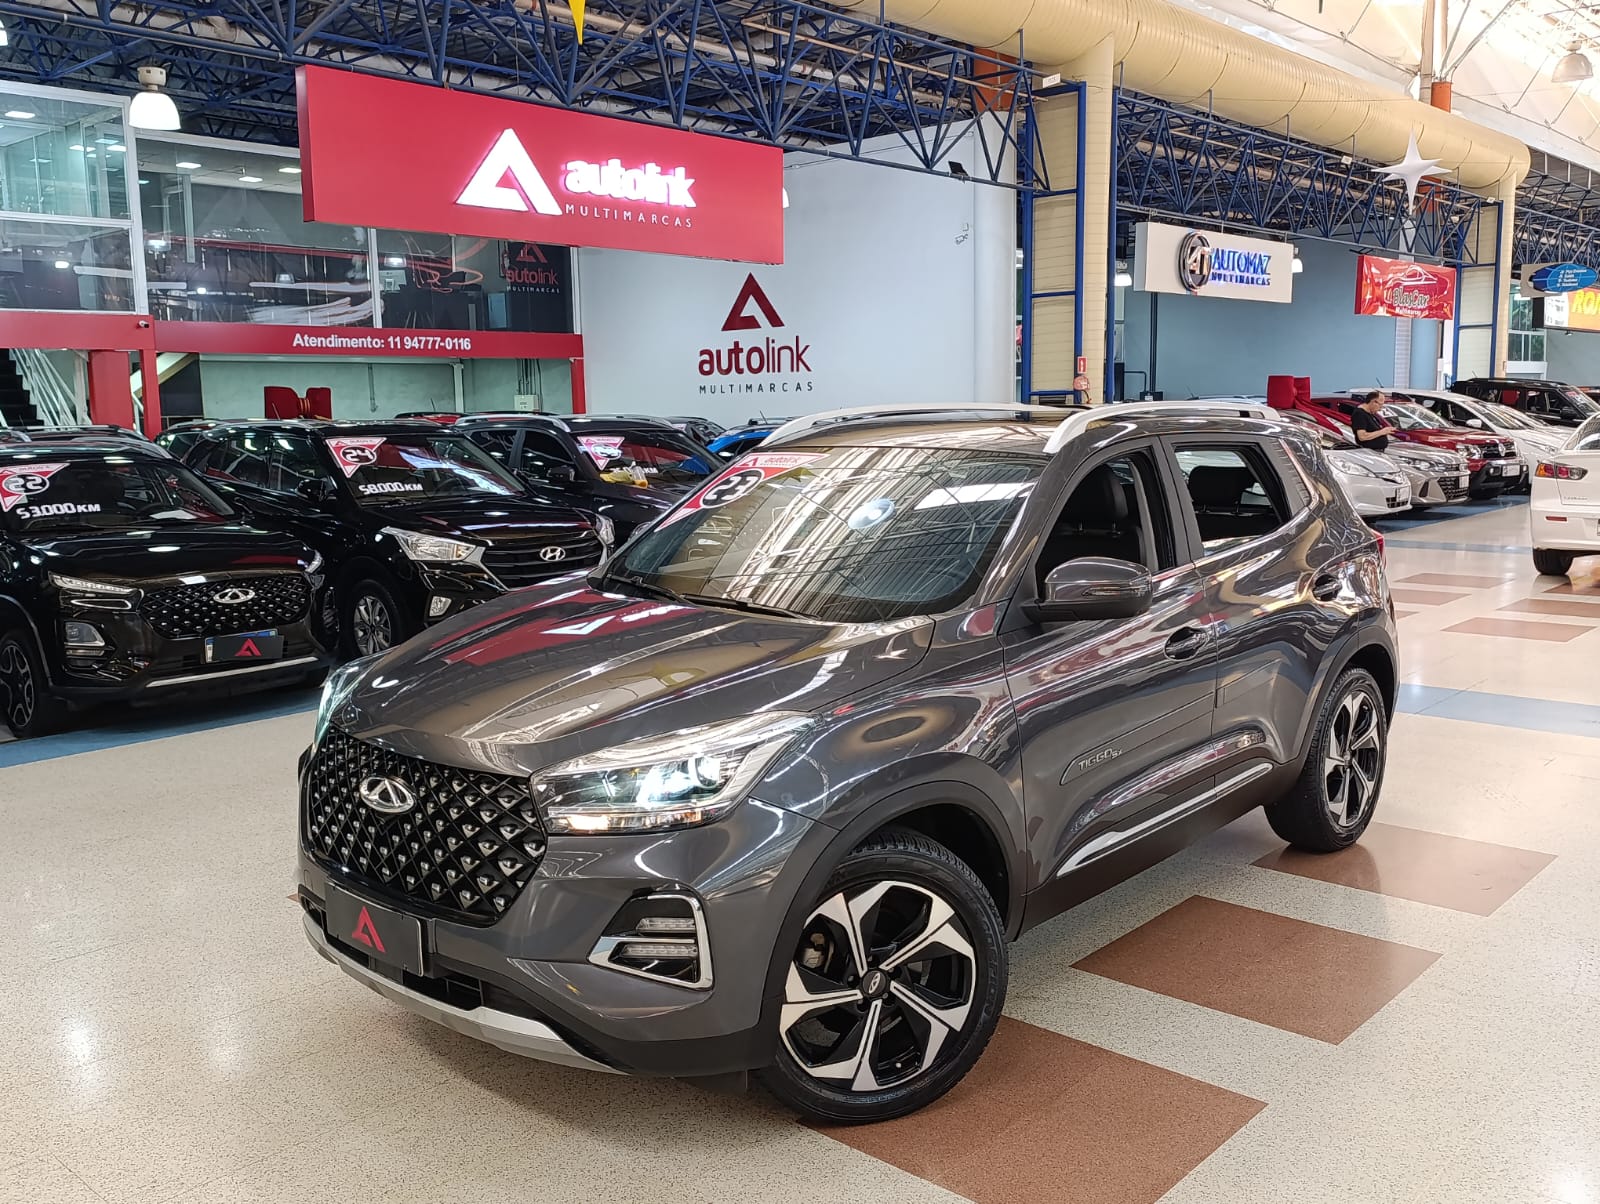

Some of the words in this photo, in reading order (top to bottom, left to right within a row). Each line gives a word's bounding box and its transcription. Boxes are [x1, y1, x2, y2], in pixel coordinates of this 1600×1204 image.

[562, 158, 697, 208] autolink
[565, 203, 693, 228] MULTIMARCAS
[1211, 247, 1272, 275] AUTOMAZ
[506, 267, 559, 285] autolink
[1211, 272, 1271, 286] MULTIMARCAS
[506, 286, 560, 294] MULTIMARCAS
[293, 333, 385, 348] Atendimento:
[388, 336, 401, 349] 11
[404, 336, 471, 350] 94777-0116
[698, 335, 812, 376] autolink
[699, 381, 813, 394] MULTIMARCAS
[344, 449, 374, 462] 24
[9, 476, 43, 491] 22
[704, 476, 759, 500] 23
